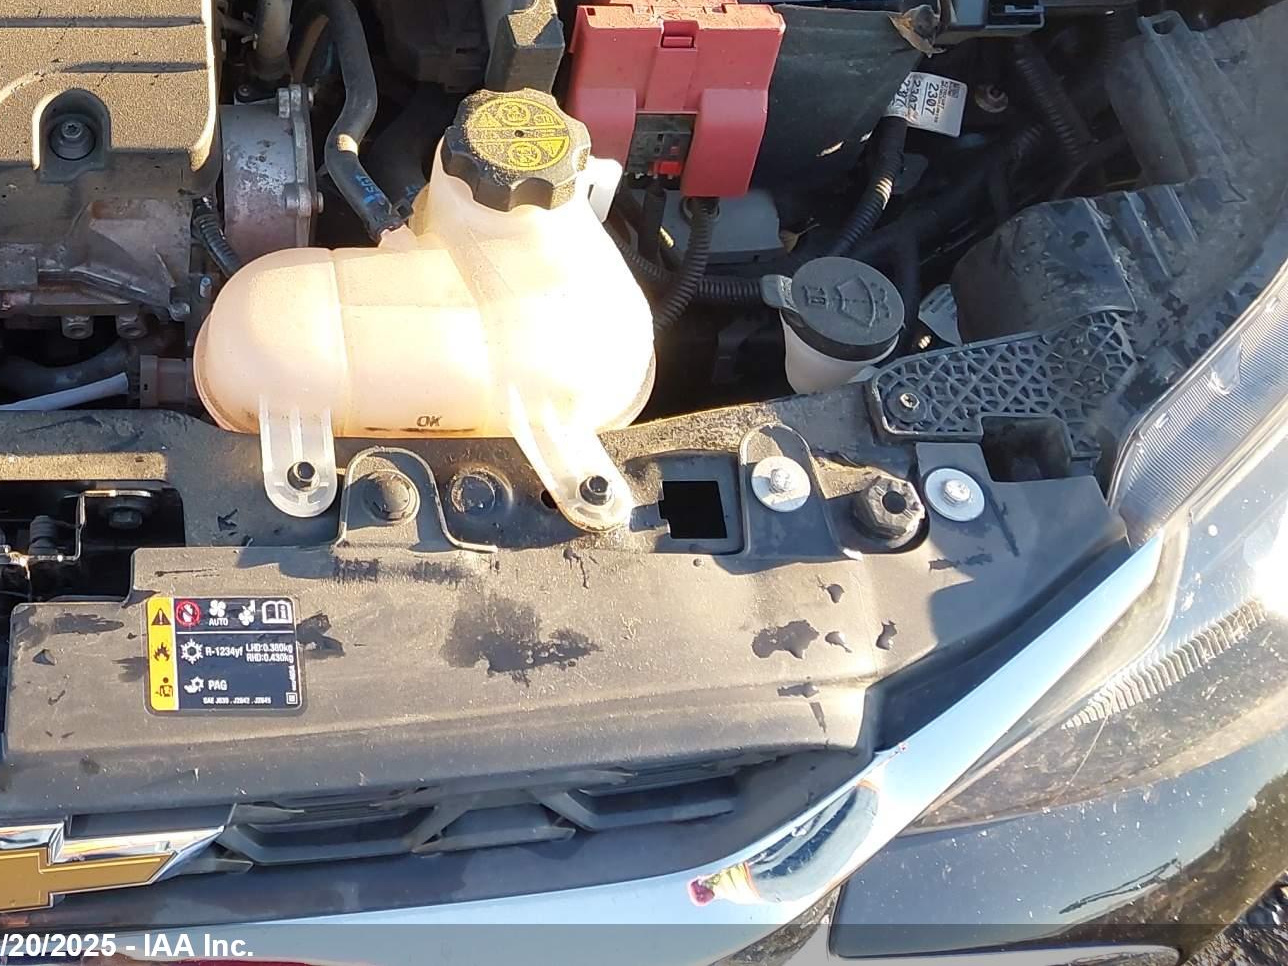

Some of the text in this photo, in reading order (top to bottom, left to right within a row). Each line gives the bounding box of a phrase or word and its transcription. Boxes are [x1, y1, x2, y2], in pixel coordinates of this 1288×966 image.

[925, 82, 940, 115] 2307
[209, 618, 228, 626] AUTO
[205, 646, 243, 658] R-1234yf
[208, 679, 228, 690] PAG
